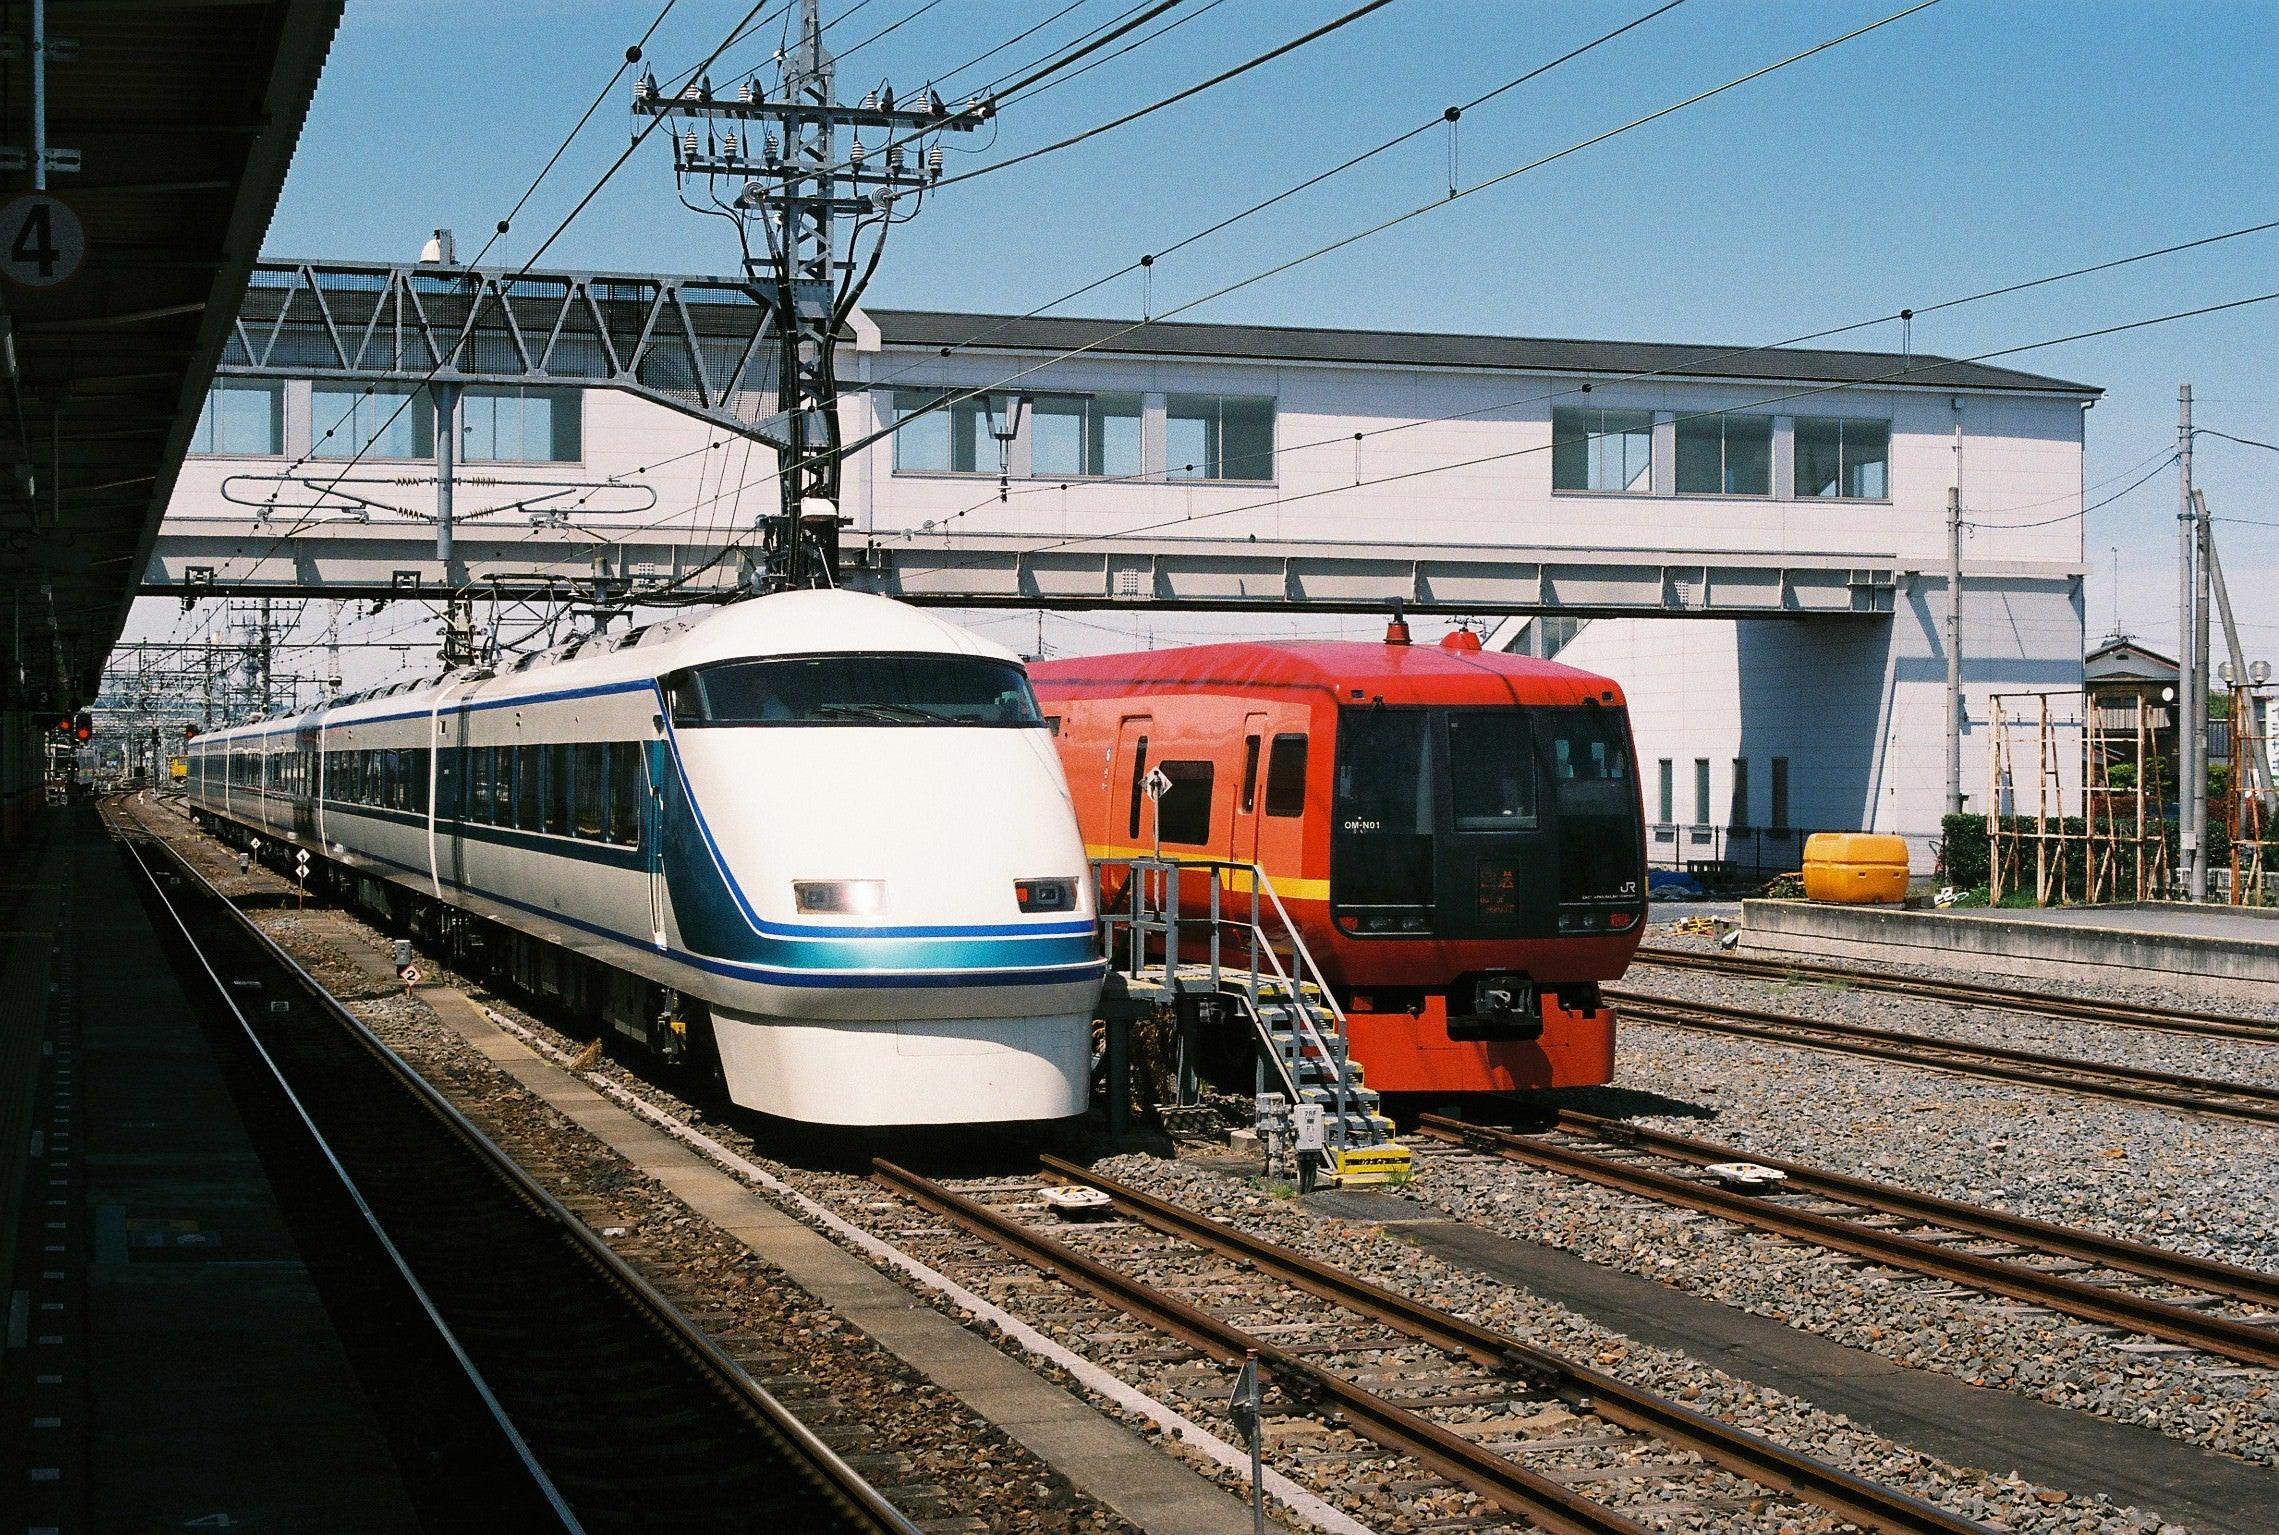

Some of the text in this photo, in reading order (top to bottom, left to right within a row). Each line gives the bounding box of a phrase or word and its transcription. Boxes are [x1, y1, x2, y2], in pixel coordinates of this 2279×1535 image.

[12, 205, 60, 277] 4
[1344, 821, 1380, 830] OM-N01
[1620, 881, 1636, 893] JR
[407, 970, 415, 981] 2
